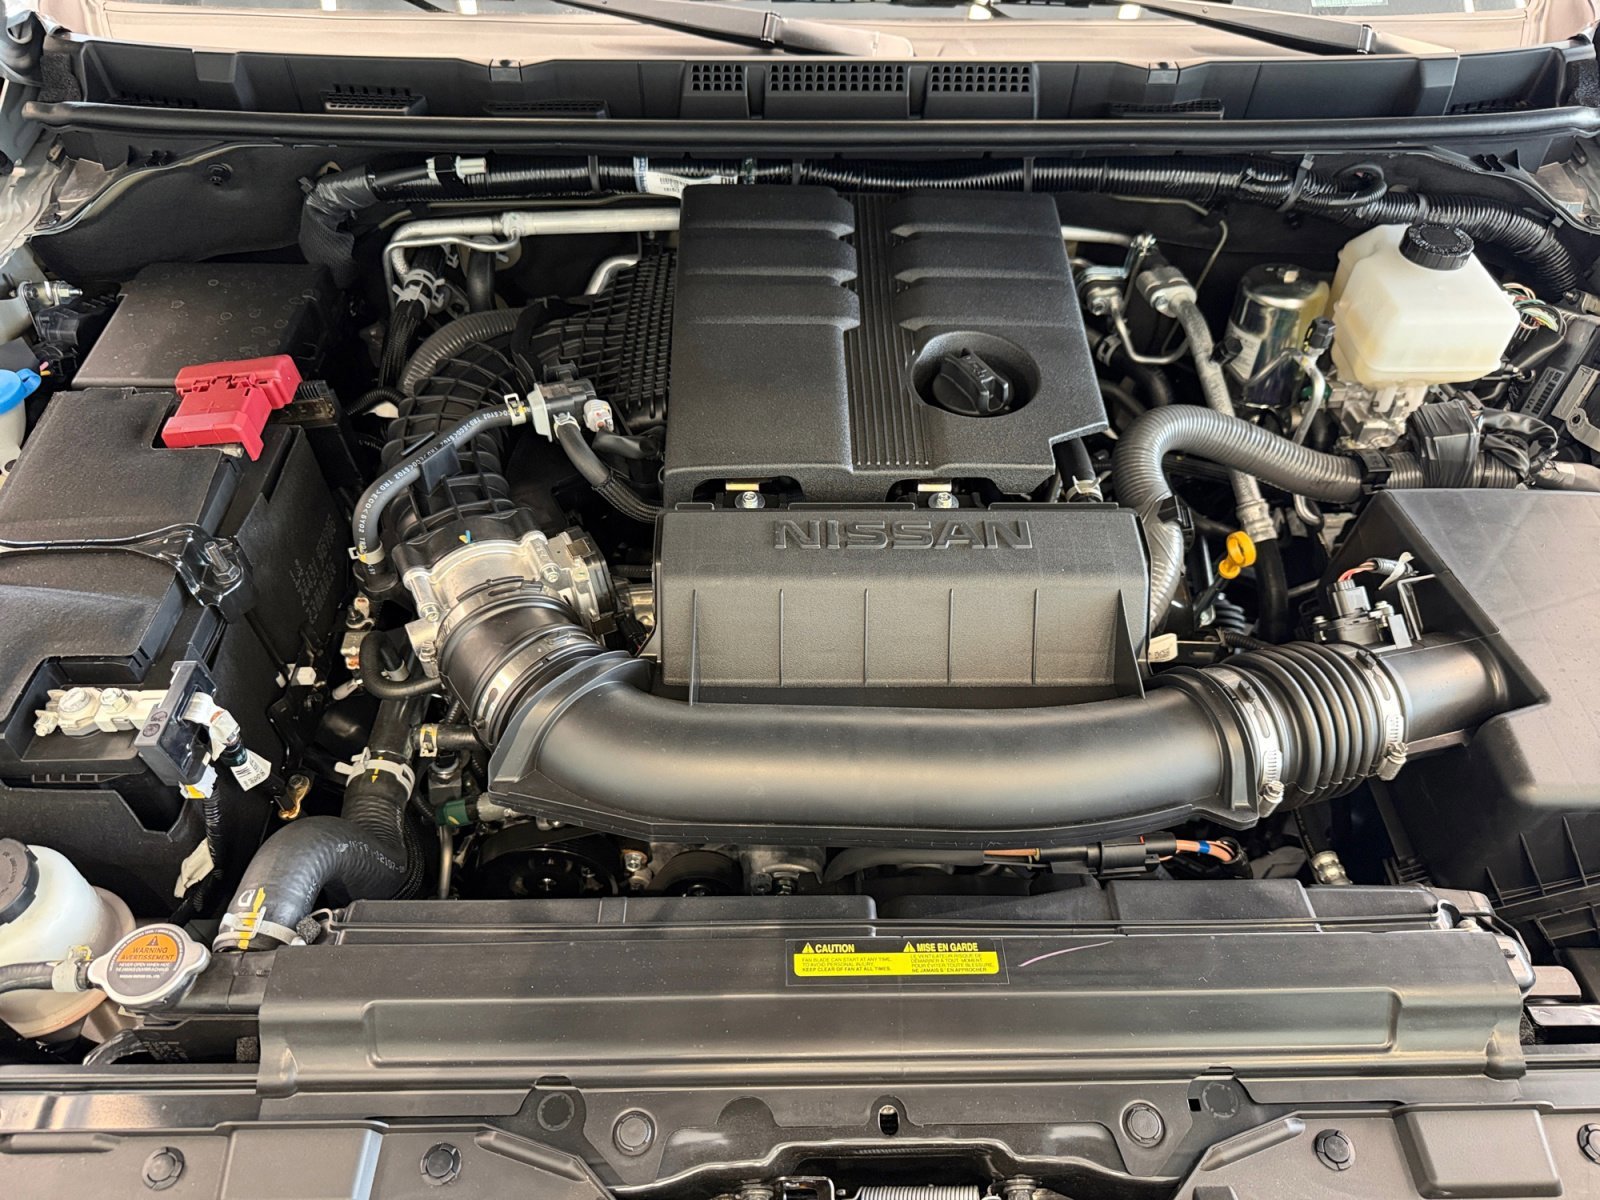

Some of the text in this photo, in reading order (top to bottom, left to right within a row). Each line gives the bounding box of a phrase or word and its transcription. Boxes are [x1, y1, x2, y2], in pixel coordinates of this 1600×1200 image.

[774, 519, 1032, 550] NISSAN
[815, 943, 855, 953] CAUTION
[916, 942, 979, 952] MISE EN GARDE
